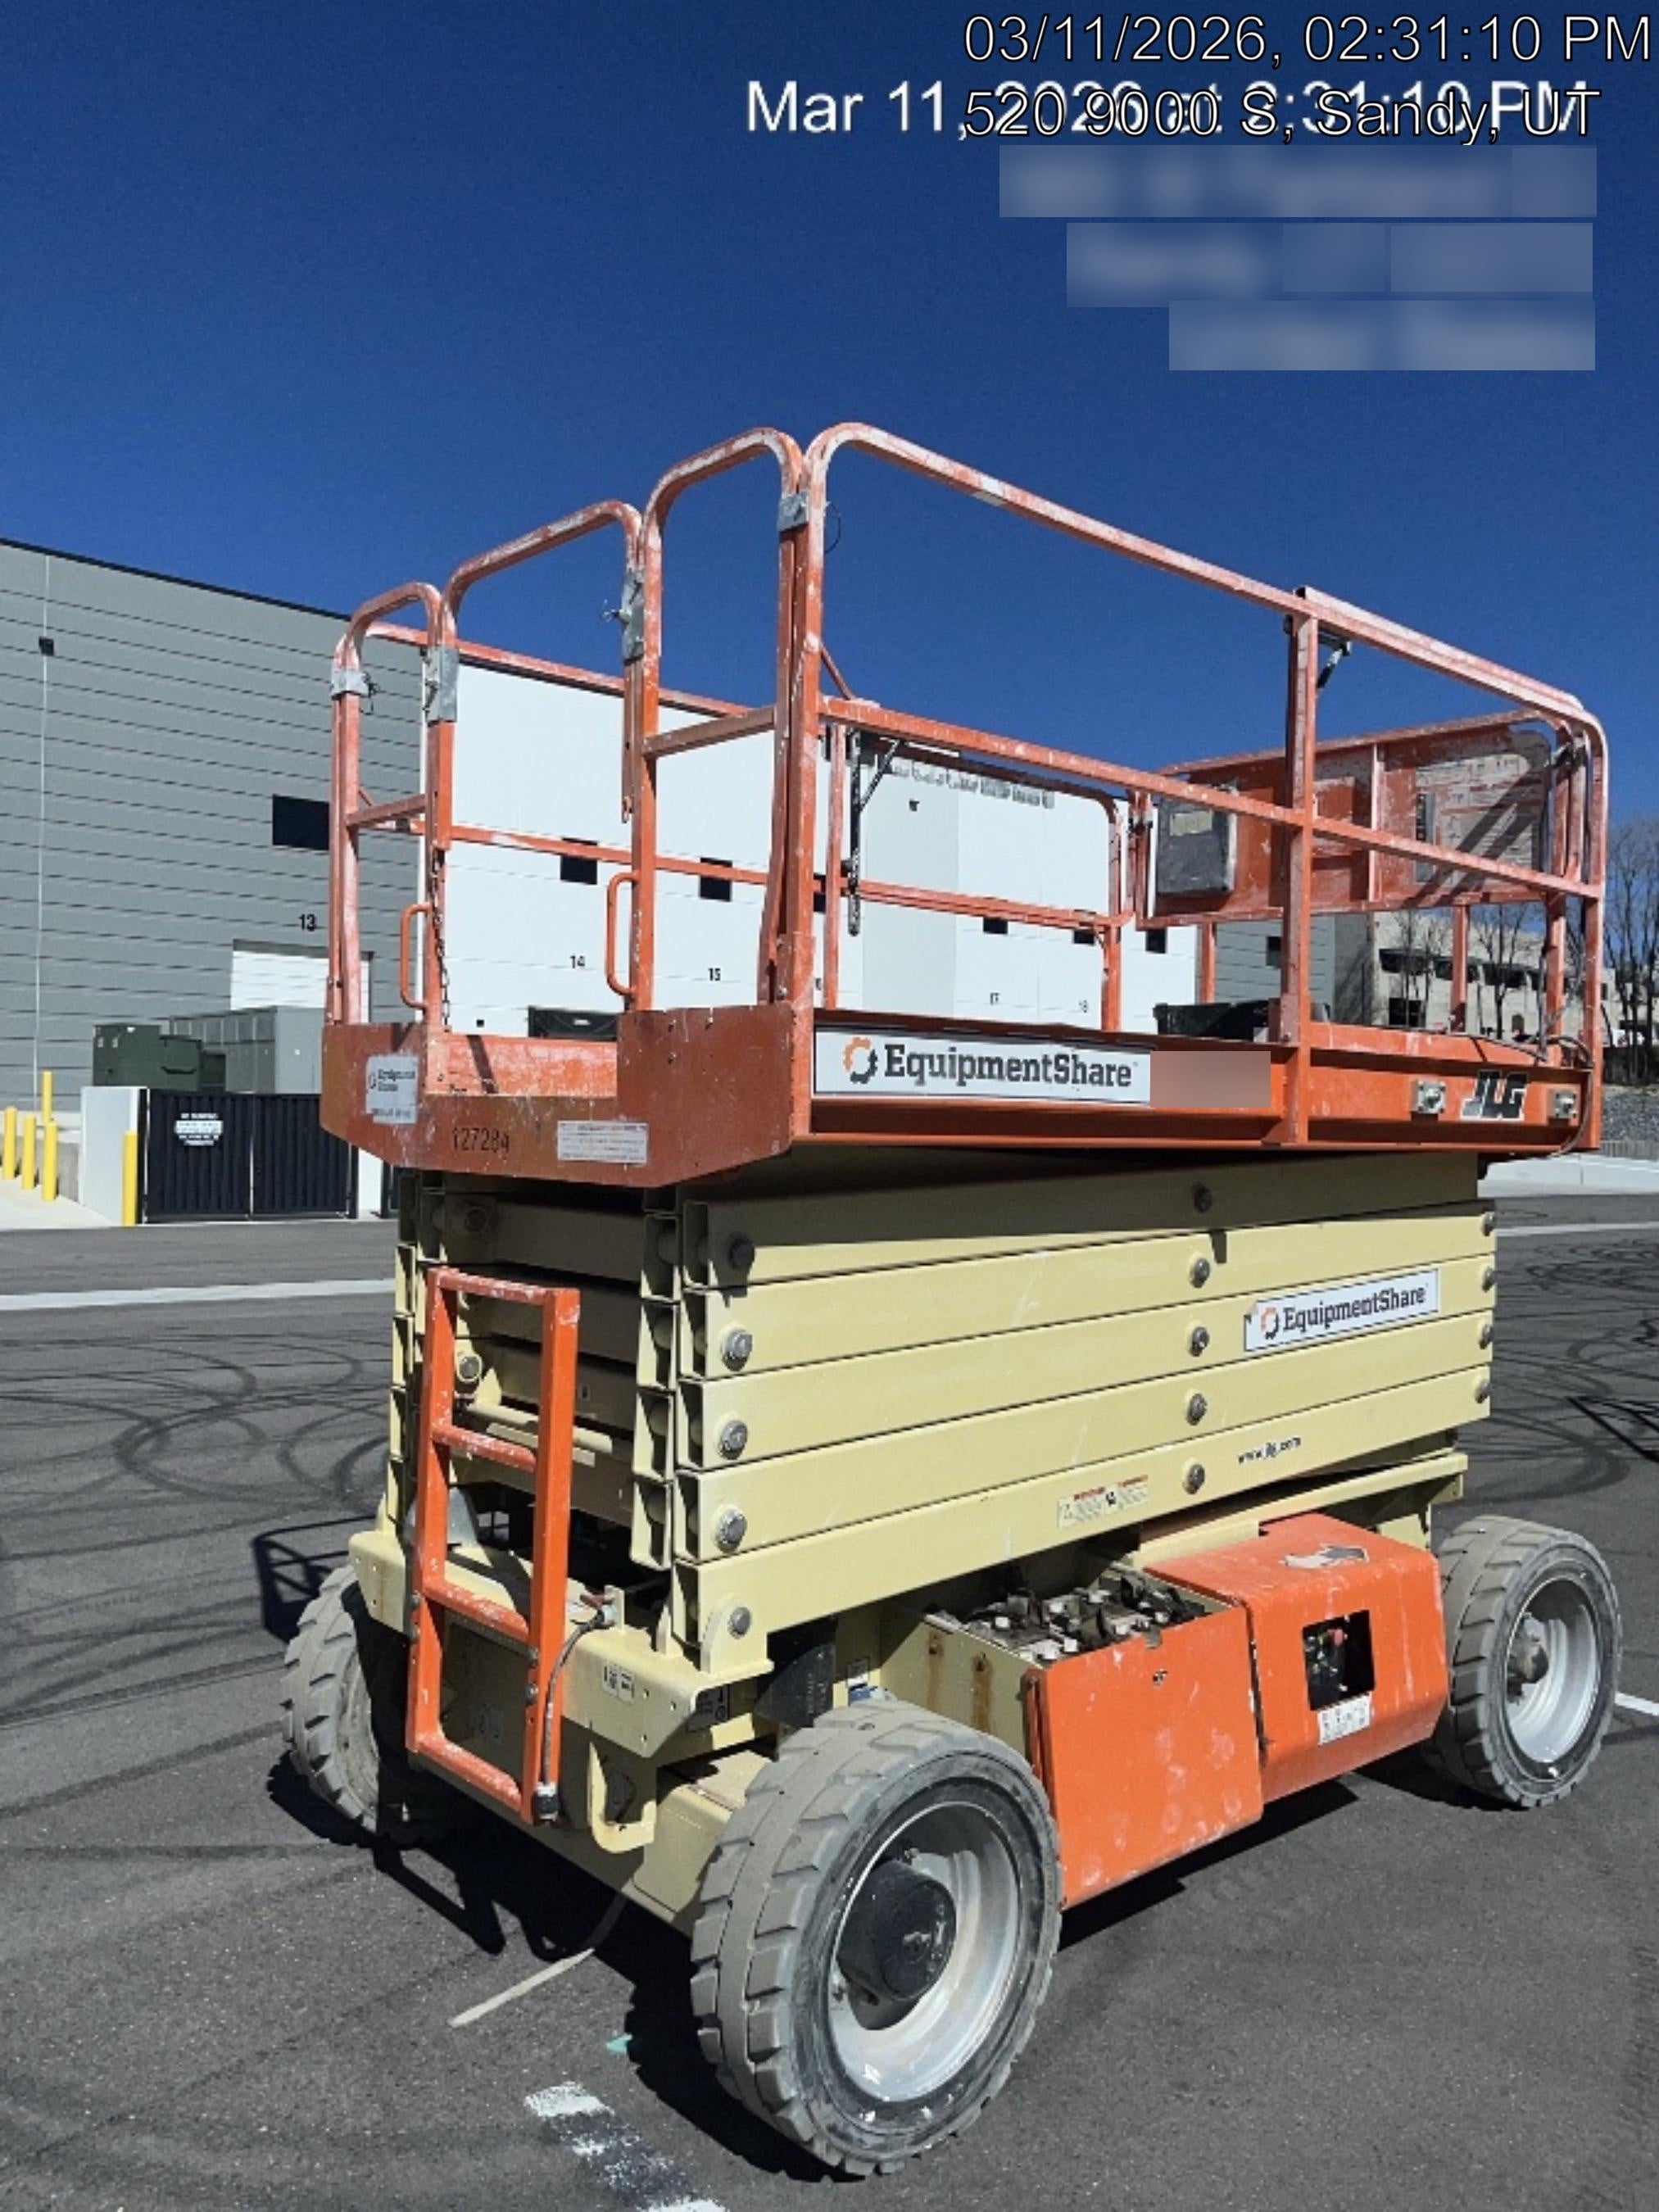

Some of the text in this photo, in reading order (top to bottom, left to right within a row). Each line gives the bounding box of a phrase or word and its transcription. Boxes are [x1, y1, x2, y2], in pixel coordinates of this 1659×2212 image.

[298, 913, 317, 932] 13
[708, 968, 721, 981] 15
[883, 1043, 1133, 1088] EquipmentShare
[1461, 1070, 1527, 1122] JLG
[1282, 1287, 1427, 1334] EquipmentShare
